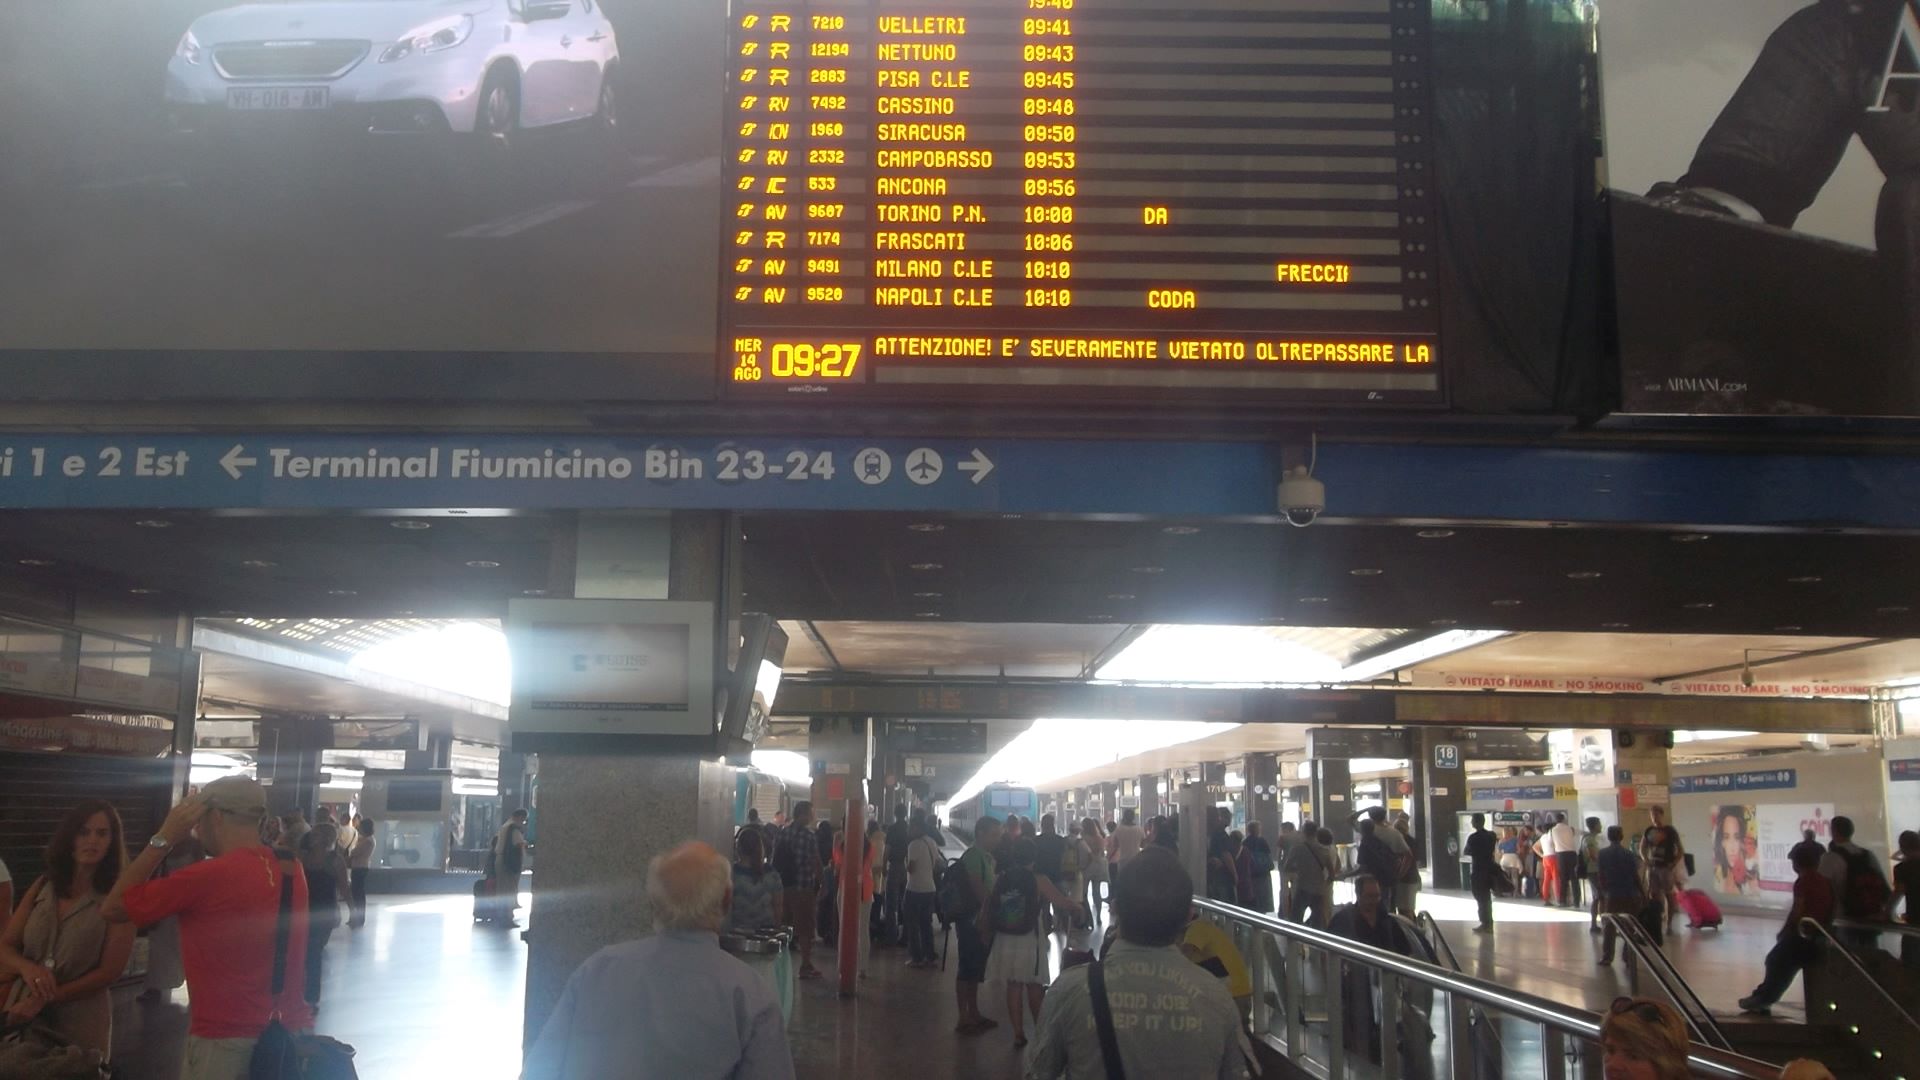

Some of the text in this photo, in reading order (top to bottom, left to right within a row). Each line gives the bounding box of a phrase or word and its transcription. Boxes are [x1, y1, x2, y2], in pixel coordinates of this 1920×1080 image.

[812, 16, 844, 31] 7210
[879, 16, 965, 34] VELLETRI
[1024, 19, 1070, 35] 09:41
[812, 43, 849, 56] 12194
[879, 44, 956, 60] NETTUNO
[1024, 45, 1073, 61] 09:43
[879, 71, 920, 87] PISA
[932, 71, 969, 87] C.LE
[1024, 72, 1073, 88] 09:45
[769, 96, 1074, 115] RV 7492 CASSINO 09:48
[879, 124, 965, 141] SIRACUSA
[1025, 125, 1074, 142] 09:50
[767, 150, 1074, 168] RV 2332 CAMPOBASSO 09:53
[878, 178, 945, 195] ANCONA
[1025, 179, 1075, 196] 09:56
[766, 205, 787, 219] AV
[878, 205, 940, 221] TORINO
[953, 205, 985, 222] P.N.
[1025, 207, 1072, 223] 10:00
[1145, 208, 1167, 224] DA
[808, 232, 840, 245] 7174
[877, 233, 964, 249] FRASCATI
[1026, 234, 1072, 251] 10:06
[765, 260, 785, 274] AV
[808, 260, 839, 273] 9491
[877, 260, 941, 277] MILANO
[954, 261, 992, 277] C.LE
[1026, 262, 1070, 278] 10:10
[765, 288, 1194, 308] AV 9520 NAPOLI C.LE 10:10 CODA
[735, 339, 761, 352] MER
[876, 338, 991, 355] ATTENZIONE!
[1031, 339, 1156, 358] SEVERAMENTE
[1170, 342, 1244, 359] VIETATO
[1257, 343, 1393, 361] OLTREPASSARE
[1406, 345, 1428, 362] LA
[741, 354, 756, 367] 14
[772, 344, 861, 376] 09:27
[735, 366, 761, 380] AGO
[0, 447, 190, 477] i 1 e 2 Est
[270, 448, 836, 481] Terminal Fiumicino Bin 23-24
[1459, 677, 1505, 687] VIETATO
[1509, 679, 1554, 689] FUMARE
[1566, 680, 1584, 689] NO
[1588, 681, 1644, 691] SMOKING
[1685, 684, 1730, 693] VIETATO
[1792, 685, 1809, 695] NO
[1440, 748, 1454, 759] 18
